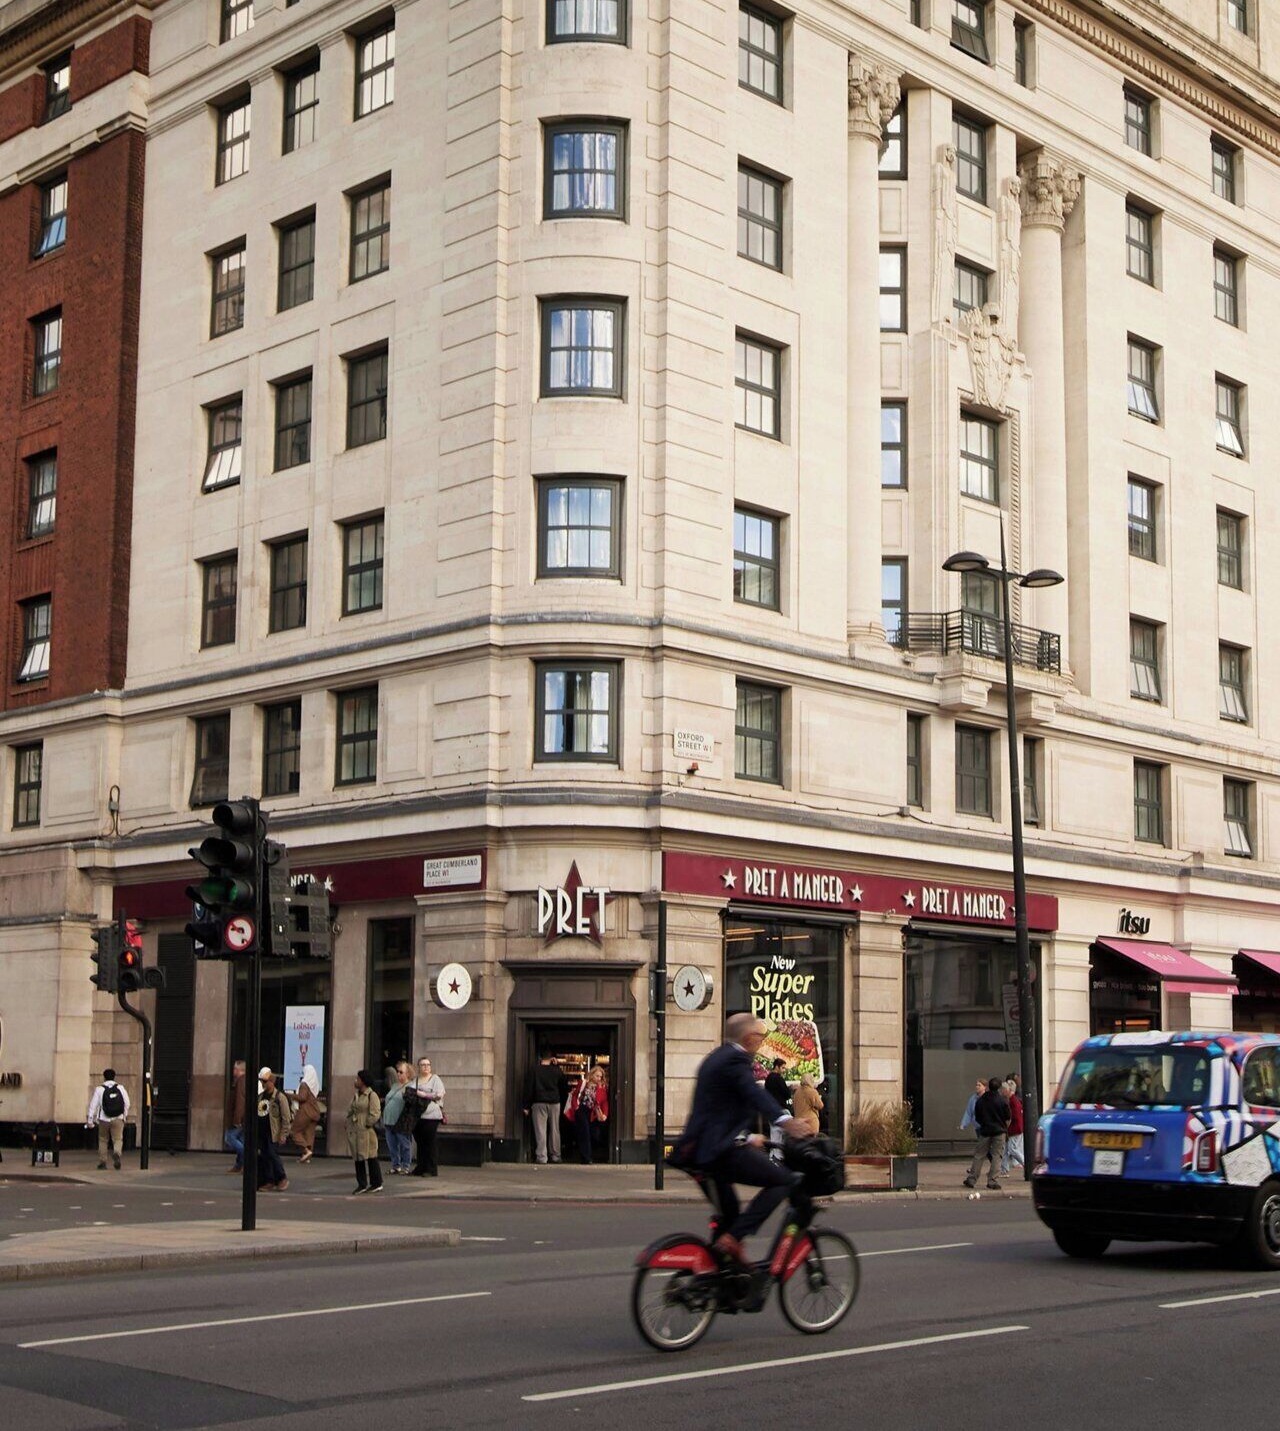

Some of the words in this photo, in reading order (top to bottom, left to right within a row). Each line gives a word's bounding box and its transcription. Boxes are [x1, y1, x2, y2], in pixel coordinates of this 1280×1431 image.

[677, 731, 704, 743] OXFORD
[677, 740, 701, 751] STREET
[426, 861, 442, 869] GREAT
[443, 858, 478, 868] CUMBERLAND
[426, 870, 441, 878] PLACE
[745, 866, 777, 897] PRET
[780, 870, 789, 898] A
[793, 871, 844, 904] MANGER
[538, 885, 611, 935] PRET
[922, 886, 949, 914] PRET
[952, 890, 960, 916] A
[963, 891, 1006, 920] MANGER
[1119, 908, 1151, 935] itsu
[770, 955, 796, 970] New
[750, 966, 815, 1000] Super
[750, 994, 814, 1023] Plates
[293, 1022, 317, 1030] Lobster
[299, 1031, 310, 1040] Roll
